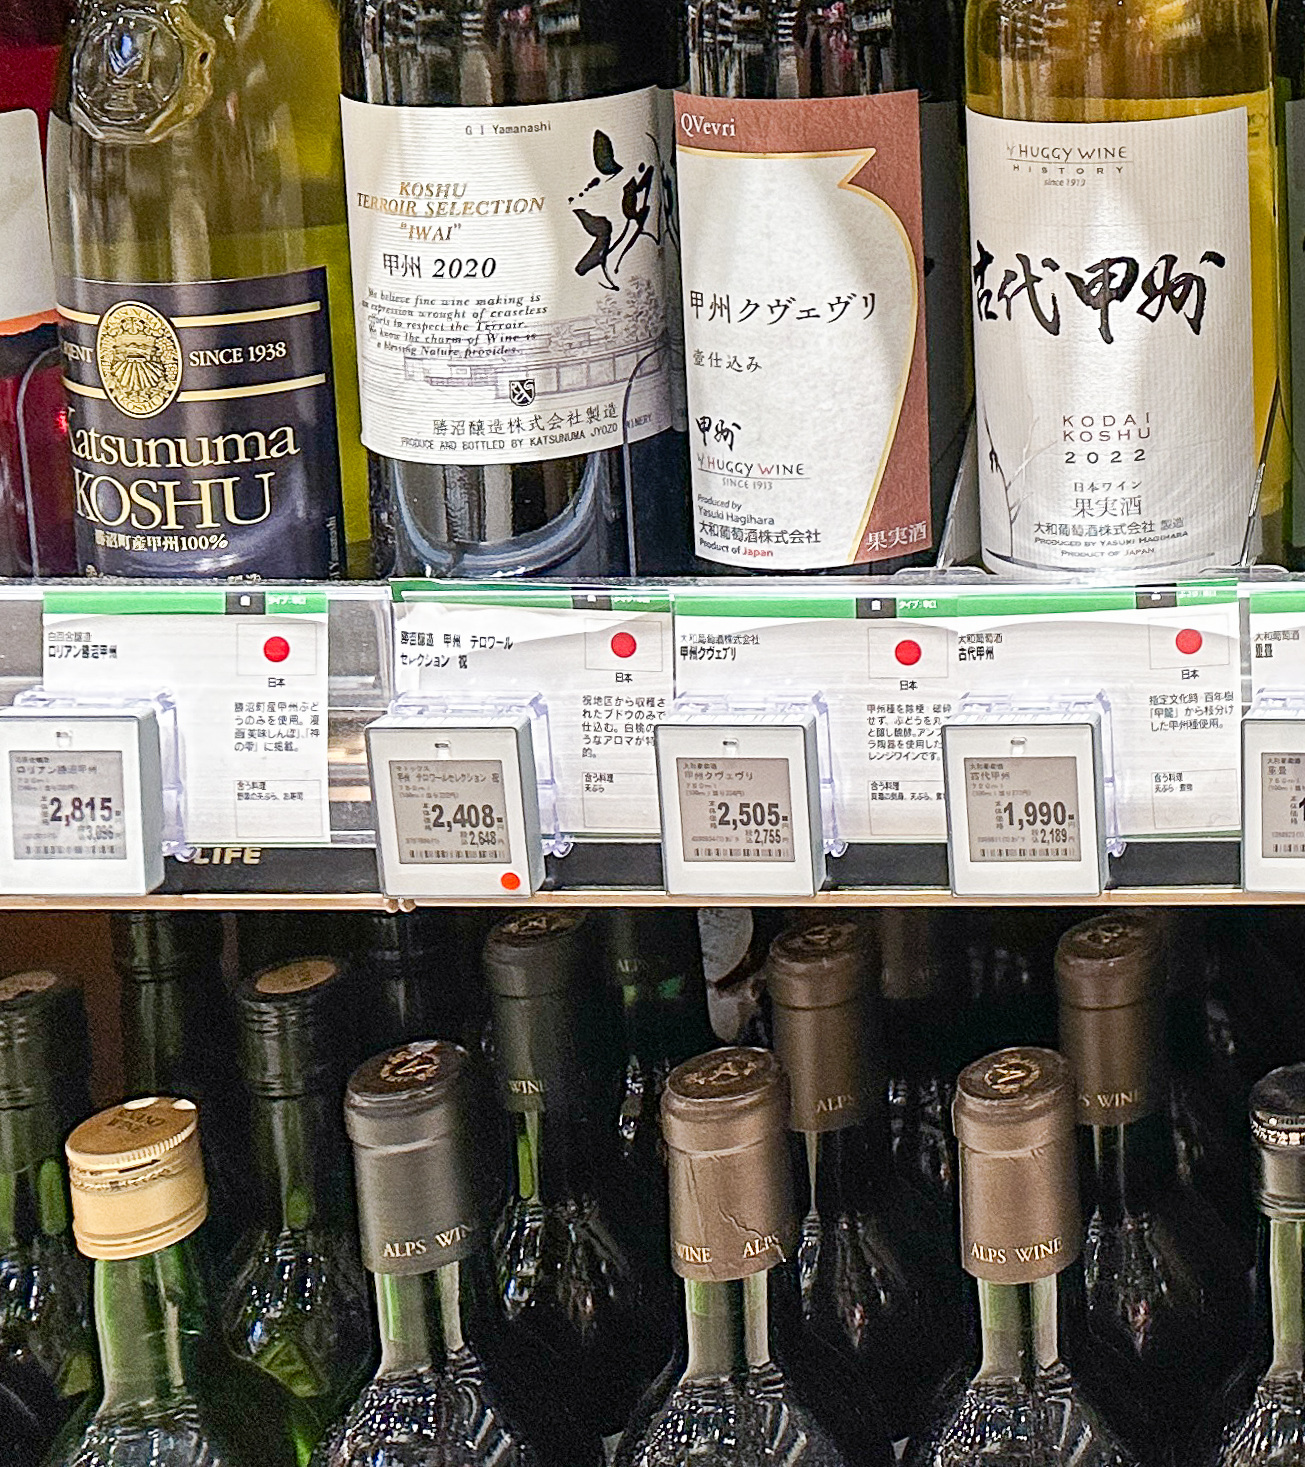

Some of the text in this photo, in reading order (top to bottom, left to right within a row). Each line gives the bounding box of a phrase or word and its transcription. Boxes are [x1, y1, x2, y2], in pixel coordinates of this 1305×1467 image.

[680, 113, 736, 137] QVevri
[1013, 164, 1124, 175] HISTORY
[383, 253, 497, 279] 甲州 2020
[972, 239, 1225, 345] 古代甲州
[689, 290, 877, 326] 甲州クヴェヴリ
[189, 343, 286, 366] SINCE 1938
[1062, 412, 1150, 428] KODAI
[1062, 428, 1151, 442] KOSHU
[1065, 450, 1146, 464] 2022
[73, 472, 275, 530] KOSHU
[1073, 495, 1143, 518] 果実酒
[865, 521, 927, 551] 果実酒
[958, 646, 995, 661] 古代甲州
[615, 672, 633, 683] 日本
[900, 680, 918, 690] 日本
[1181, 669, 1199, 679] 日本
[431, 803, 495, 832] 2,408
[717, 802, 781, 830] 2,505
[1003, 801, 1066, 830] 1,990
[971, 1238, 1063, 1264] ALPS WINE
